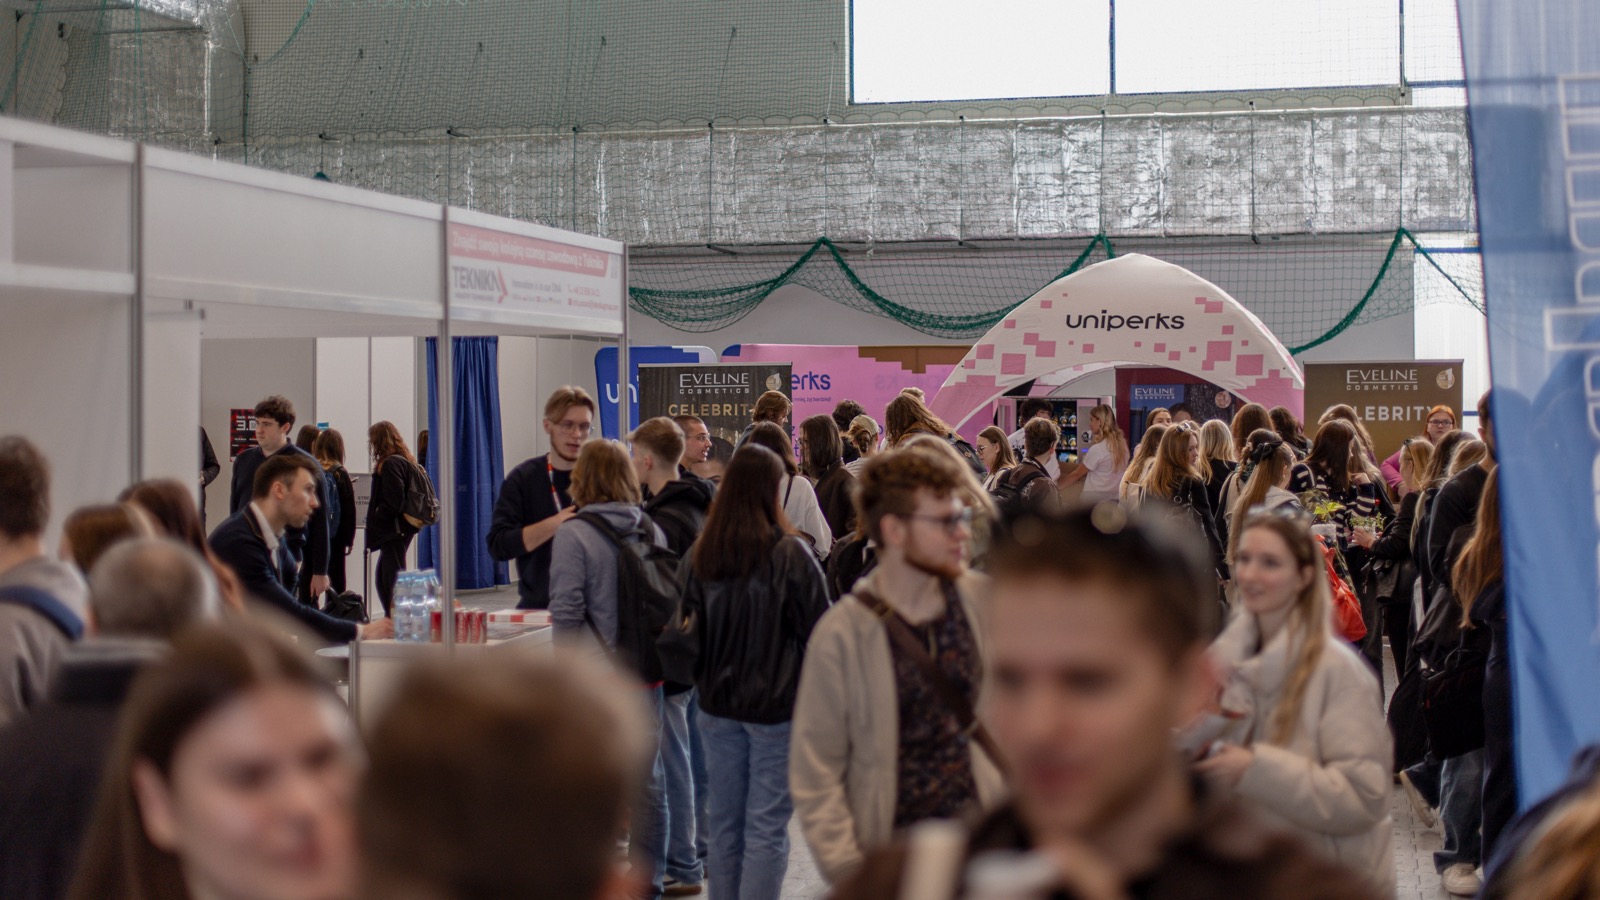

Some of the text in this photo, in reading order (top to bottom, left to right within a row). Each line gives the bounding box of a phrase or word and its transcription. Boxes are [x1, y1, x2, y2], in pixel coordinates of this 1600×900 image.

[1065, 309, 1185, 332] uniperks
[680, 373, 749, 388] EVELINE
[1346, 369, 1418, 384] EVELINE
[1135, 388, 1175, 396] EVELINE
[668, 403, 754, 416] CELEBRIT
[1353, 405, 1432, 421] LEBRIT
